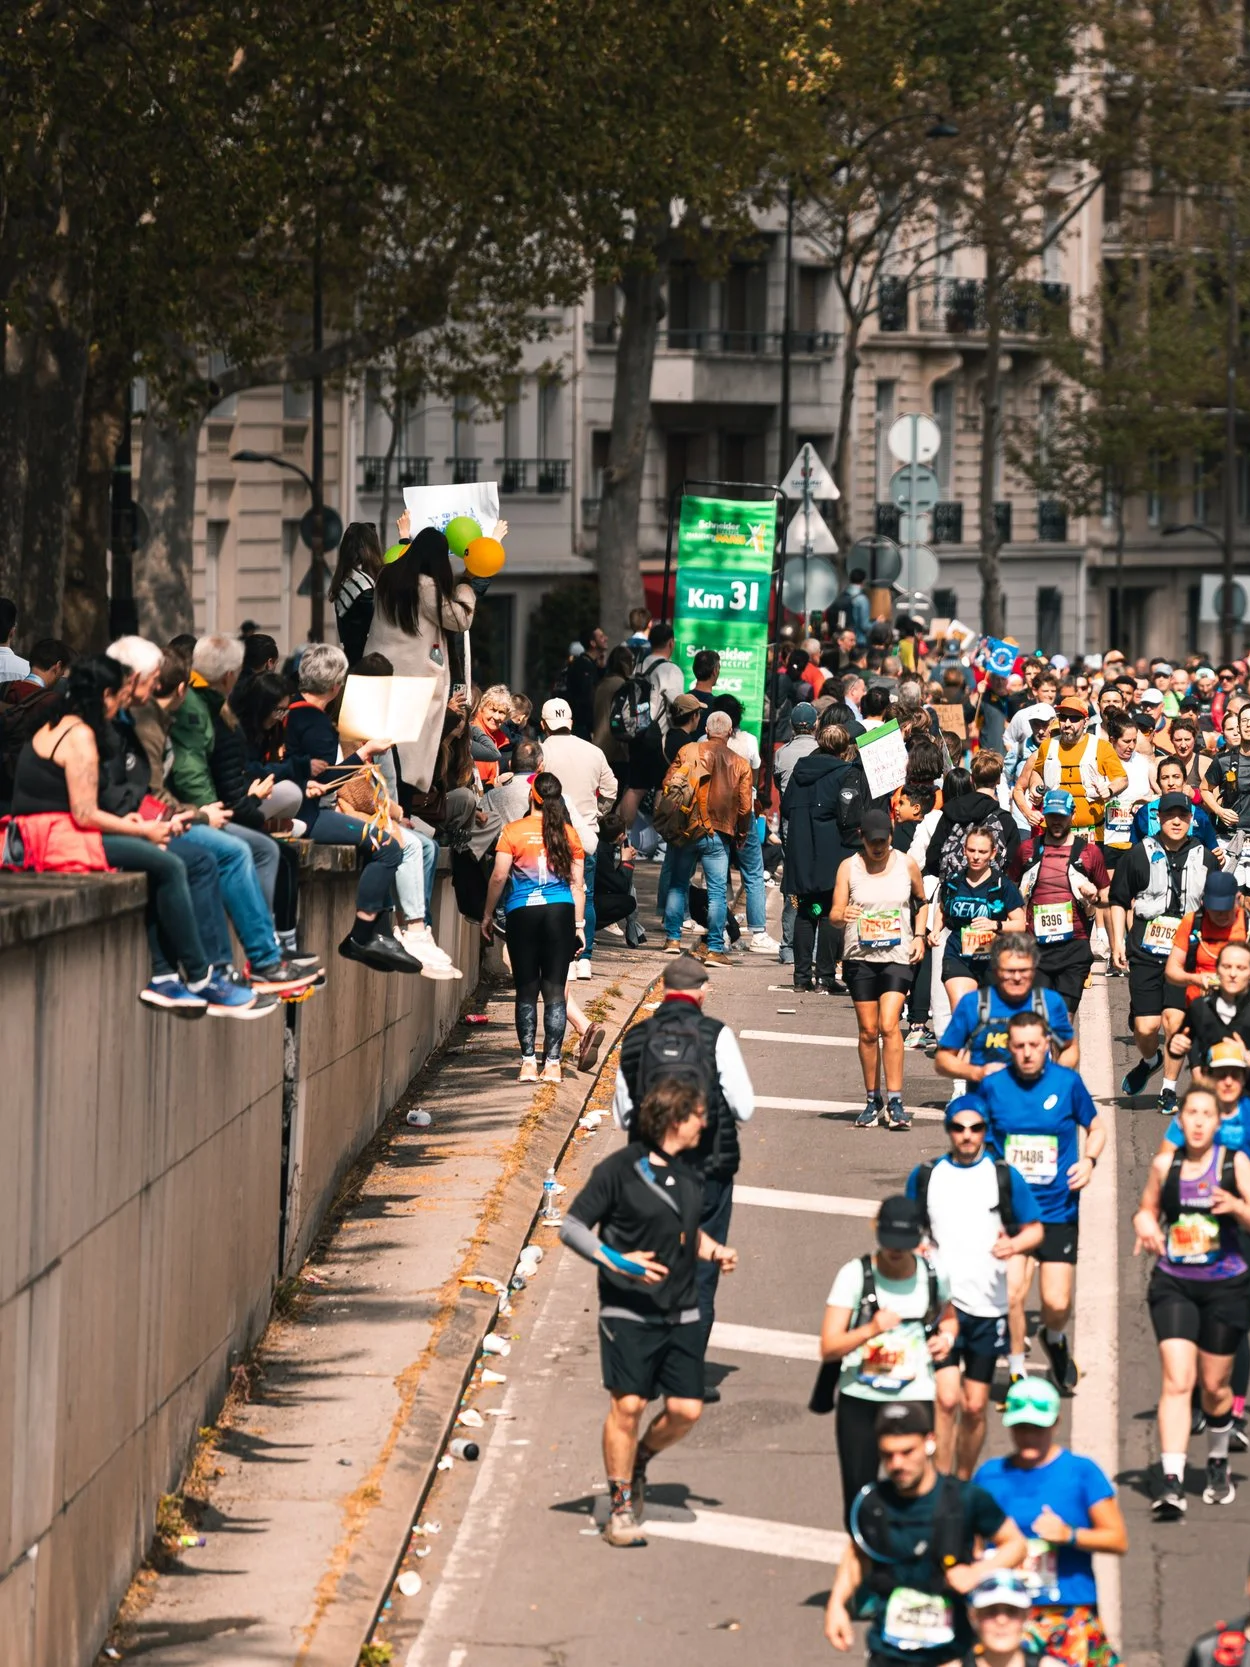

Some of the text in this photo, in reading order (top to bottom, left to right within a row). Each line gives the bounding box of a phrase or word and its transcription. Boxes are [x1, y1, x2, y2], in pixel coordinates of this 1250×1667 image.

[687, 580, 759, 612] Km 31
[1041, 913, 1063, 927] 6396
[1150, 923, 1177, 940] 69762
[1012, 1149, 1044, 1164] 71486
